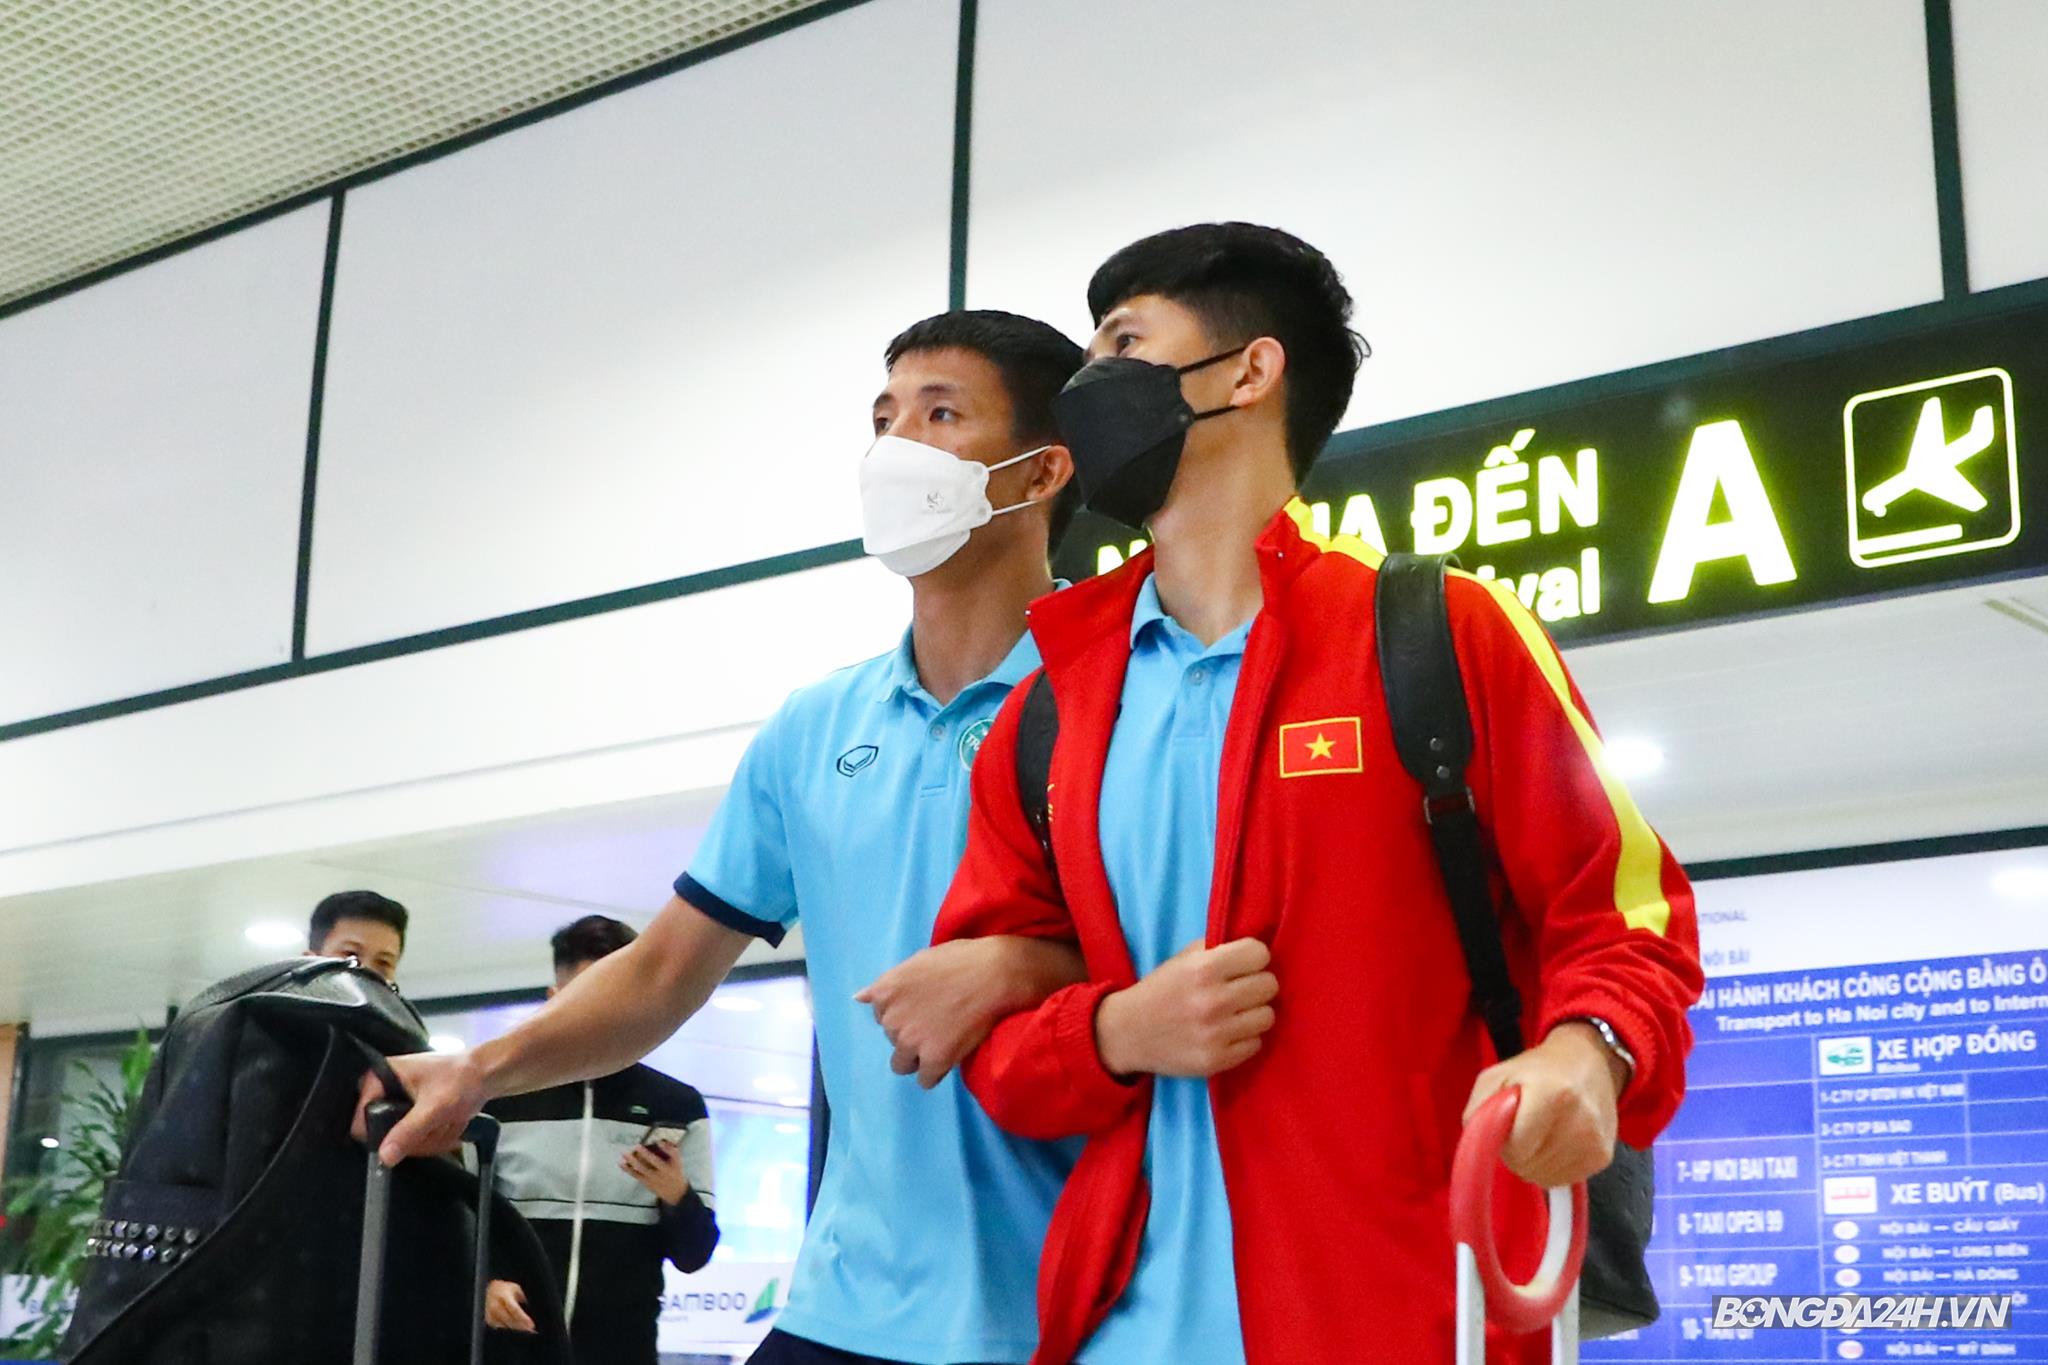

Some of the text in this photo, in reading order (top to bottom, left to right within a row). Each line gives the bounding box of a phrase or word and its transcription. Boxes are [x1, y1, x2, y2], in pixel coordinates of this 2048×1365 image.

[1410, 428, 1599, 557] ĐẾN
[1648, 419, 1798, 604] A
[1717, 981, 1770, 1008] HÀNH
[1773, 976, 1841, 1004] KHÁCH
[1843, 971, 1901, 998] CÔNG
[1904, 966, 1963, 998] CỘNG
[2029, 956, 2047, 984] Ô
[1716, 1011, 1802, 1032] Transport
[1804, 1011, 1823, 1026] to
[1826, 1007, 1852, 1024] Ha
[1856, 1004, 1888, 1021] Noi
[1891, 1002, 1926, 1022] city
[1929, 998, 1966, 1017] and
[1969, 997, 1990, 1014] to
[1877, 1038, 1908, 1060] XE
[1912, 1034, 1962, 1062] HỢP
[1890, 1183, 1922, 1204] XE
[1994, 1182, 2046, 1205] (Bus)
[1693, 1211, 1725, 1234] TAXI
[1726, 1210, 1765, 1233] OPEN
[1694, 1264, 1726, 1287] TAXI
